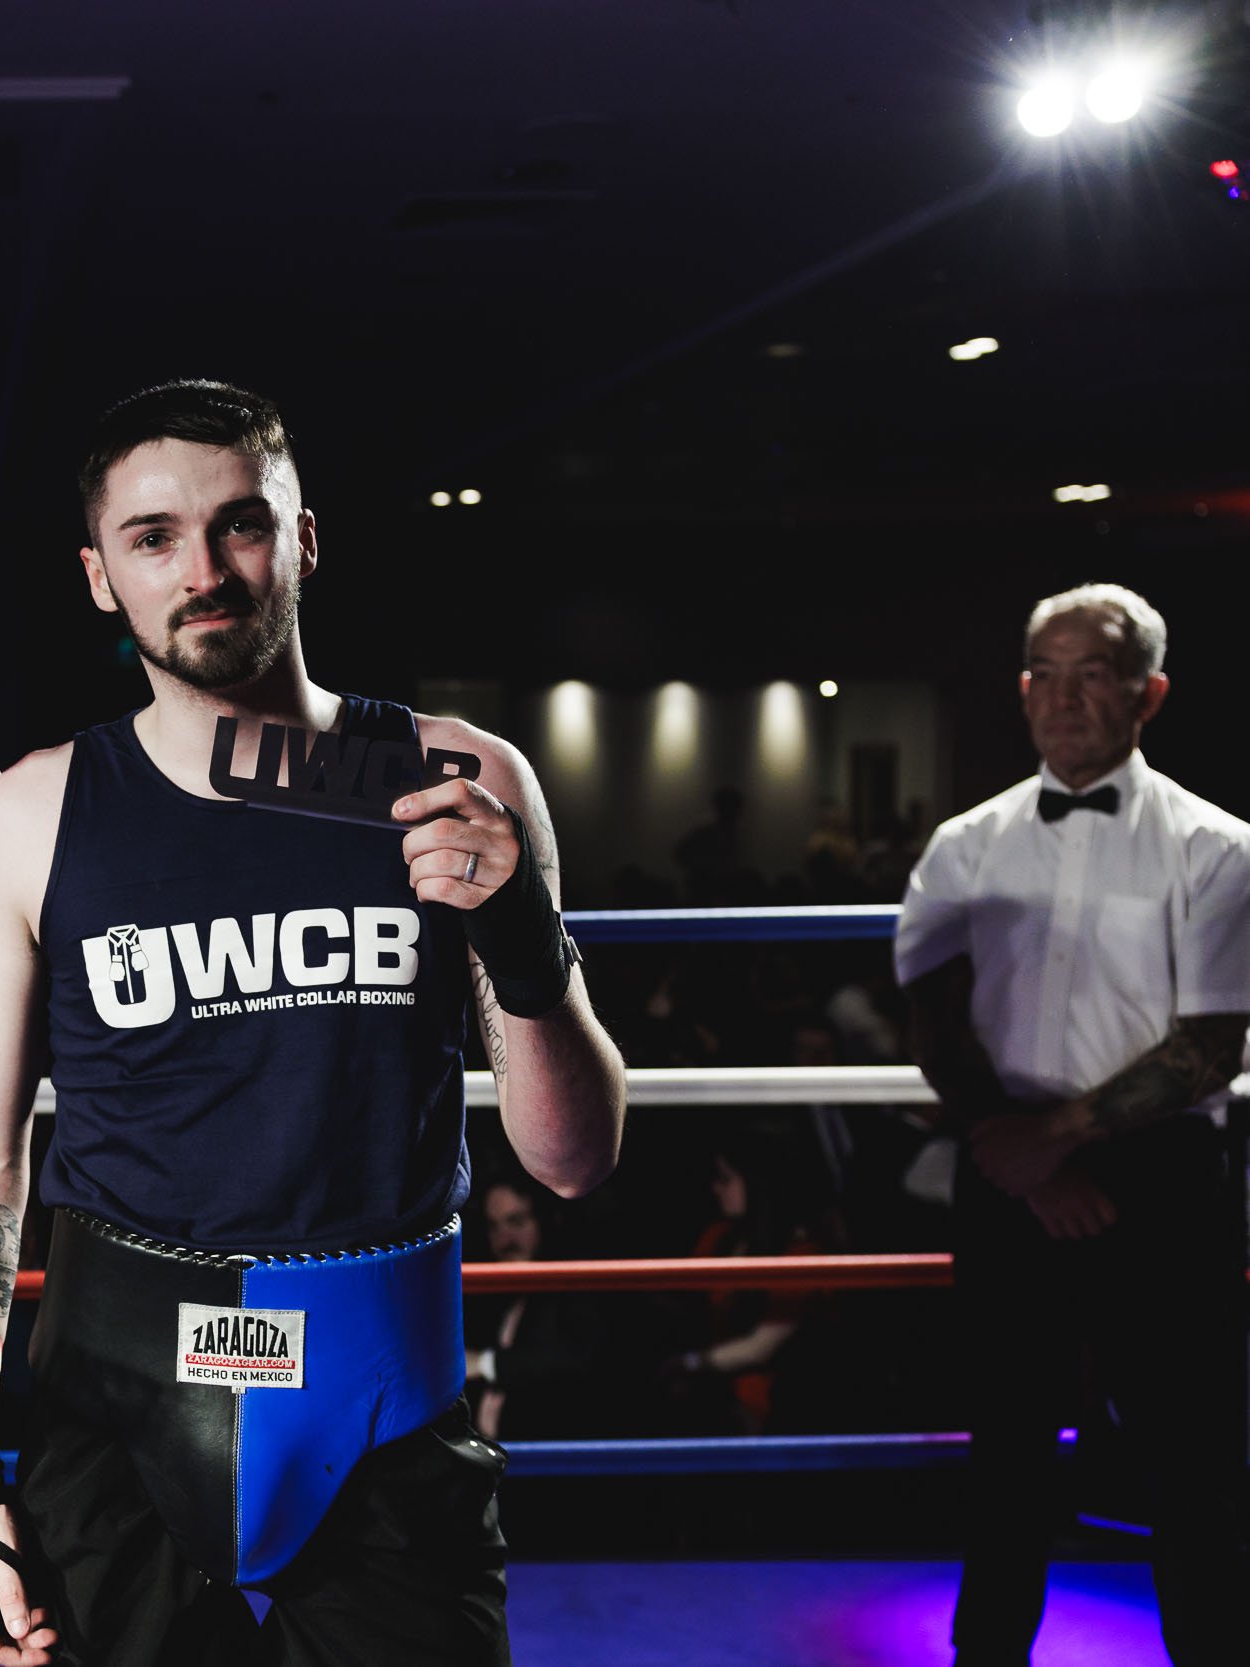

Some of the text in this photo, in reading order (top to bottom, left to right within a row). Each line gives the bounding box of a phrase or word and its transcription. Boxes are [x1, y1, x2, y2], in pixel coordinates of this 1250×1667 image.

[82, 904, 420, 1029] UWCB
[191, 990, 415, 1019] ULTRA WHITE COLLAR BOXING
[192, 1315, 289, 1358] ZARAGOZA
[187, 1354, 294, 1369] ZARAGOZAGEAR.COM
[187, 1367, 293, 1382] HECHO EN MEXICO
